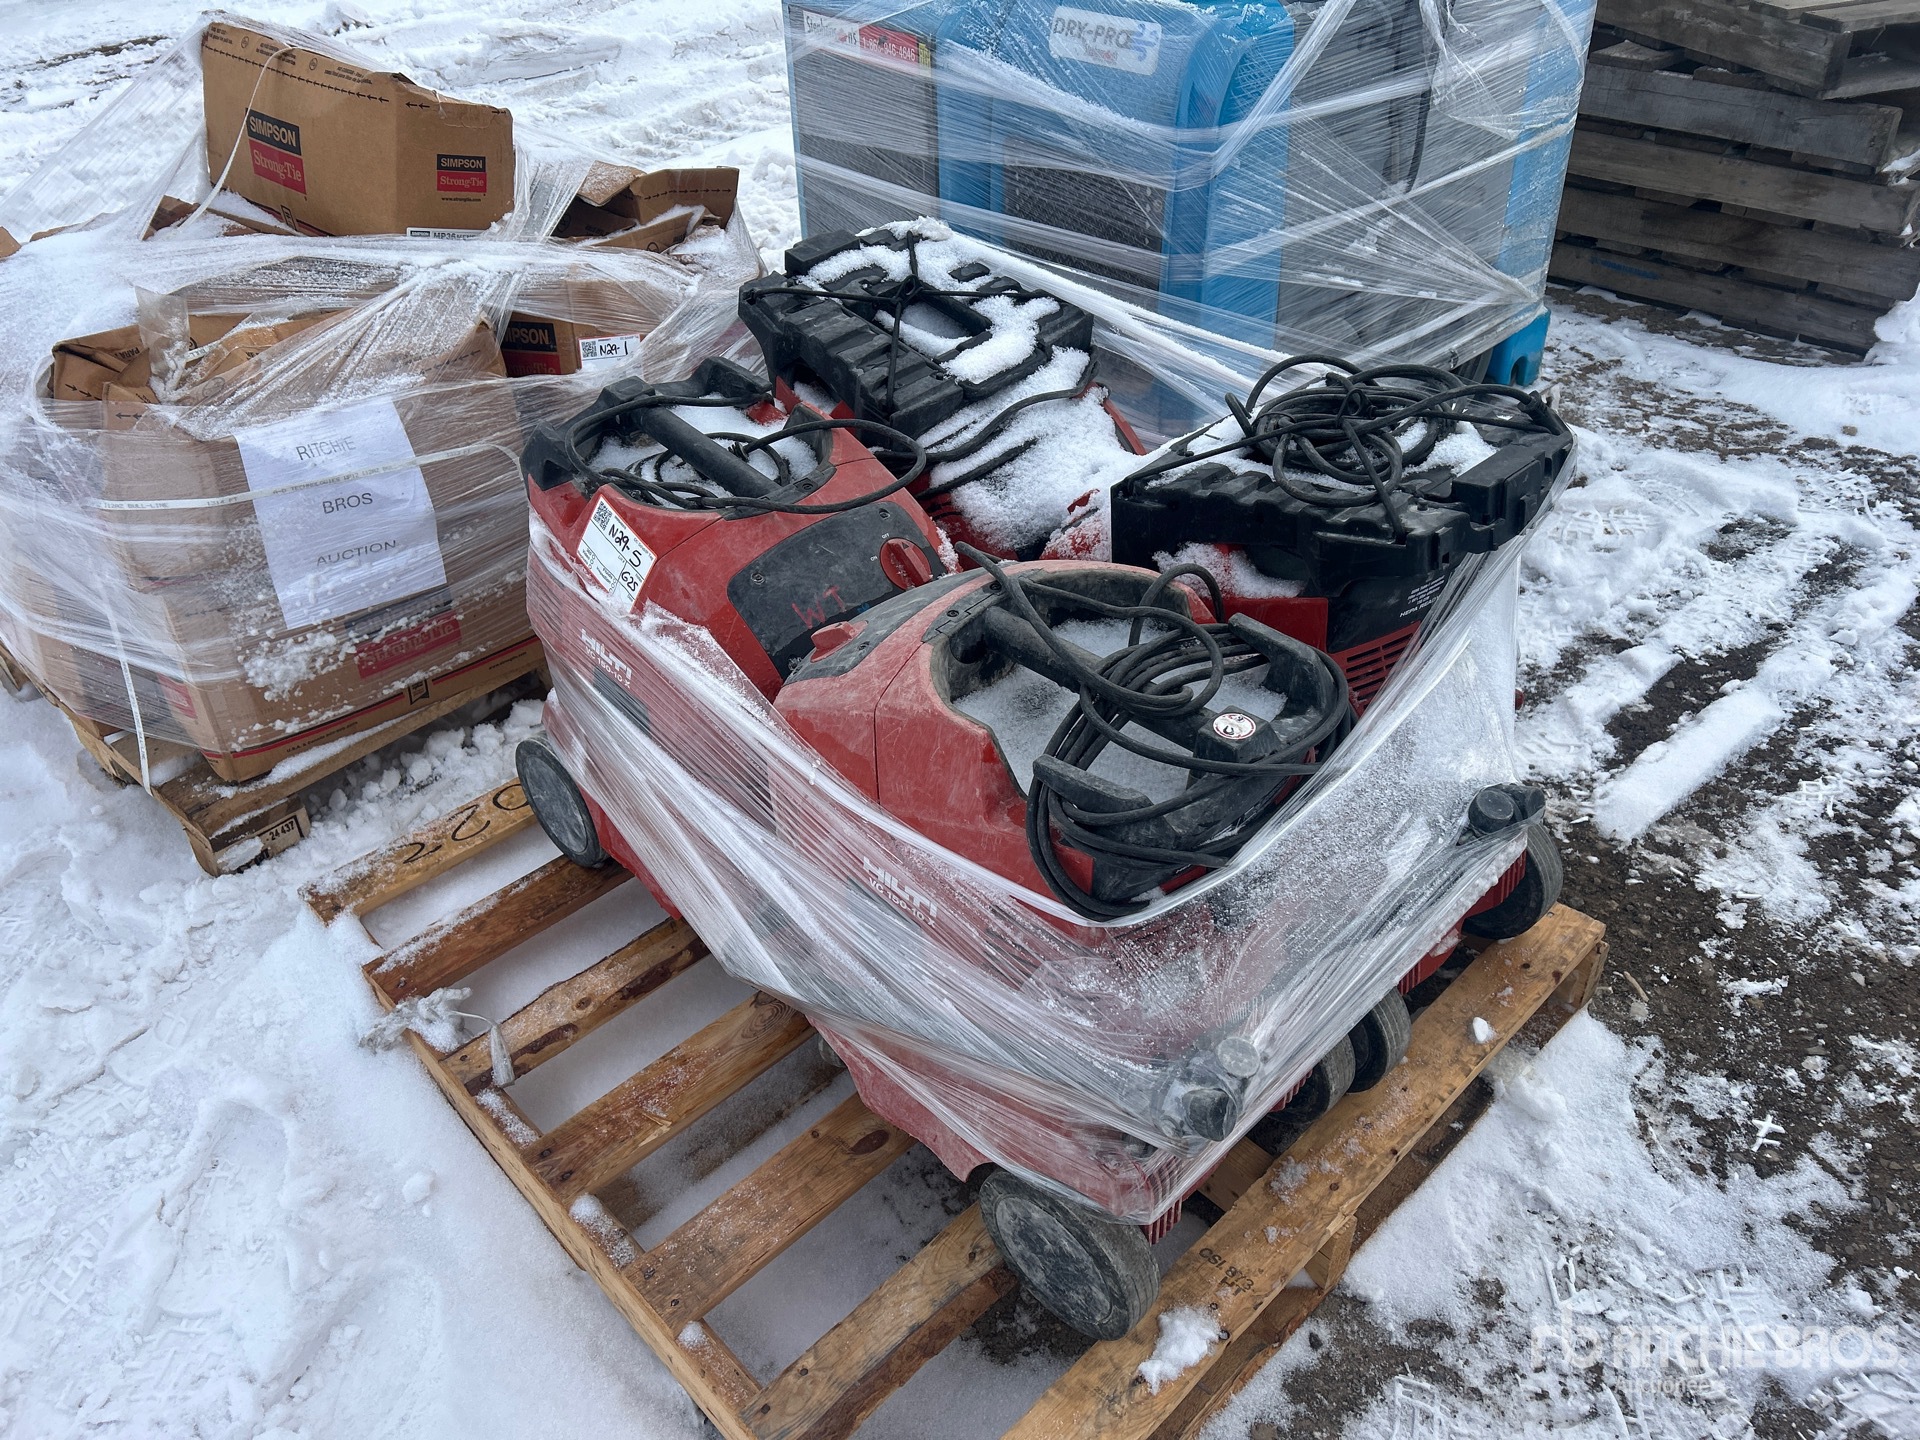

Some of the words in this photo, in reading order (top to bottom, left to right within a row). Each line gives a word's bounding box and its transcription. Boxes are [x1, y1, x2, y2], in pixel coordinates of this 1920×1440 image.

[249, 116, 296, 147] SIMPSON
[253, 149, 302, 182] Strong-Tie
[440, 157, 483, 169] SIMPSON
[440, 175, 484, 189] Strong-Tie
[296, 437, 356, 461] RITCHIE
[322, 492, 373, 514] BROS
[316, 540, 396, 567] AUCTION
[581, 628, 632, 680] HILTI
[863, 856, 937, 918] HILTI
[868, 876, 884, 894] VC
